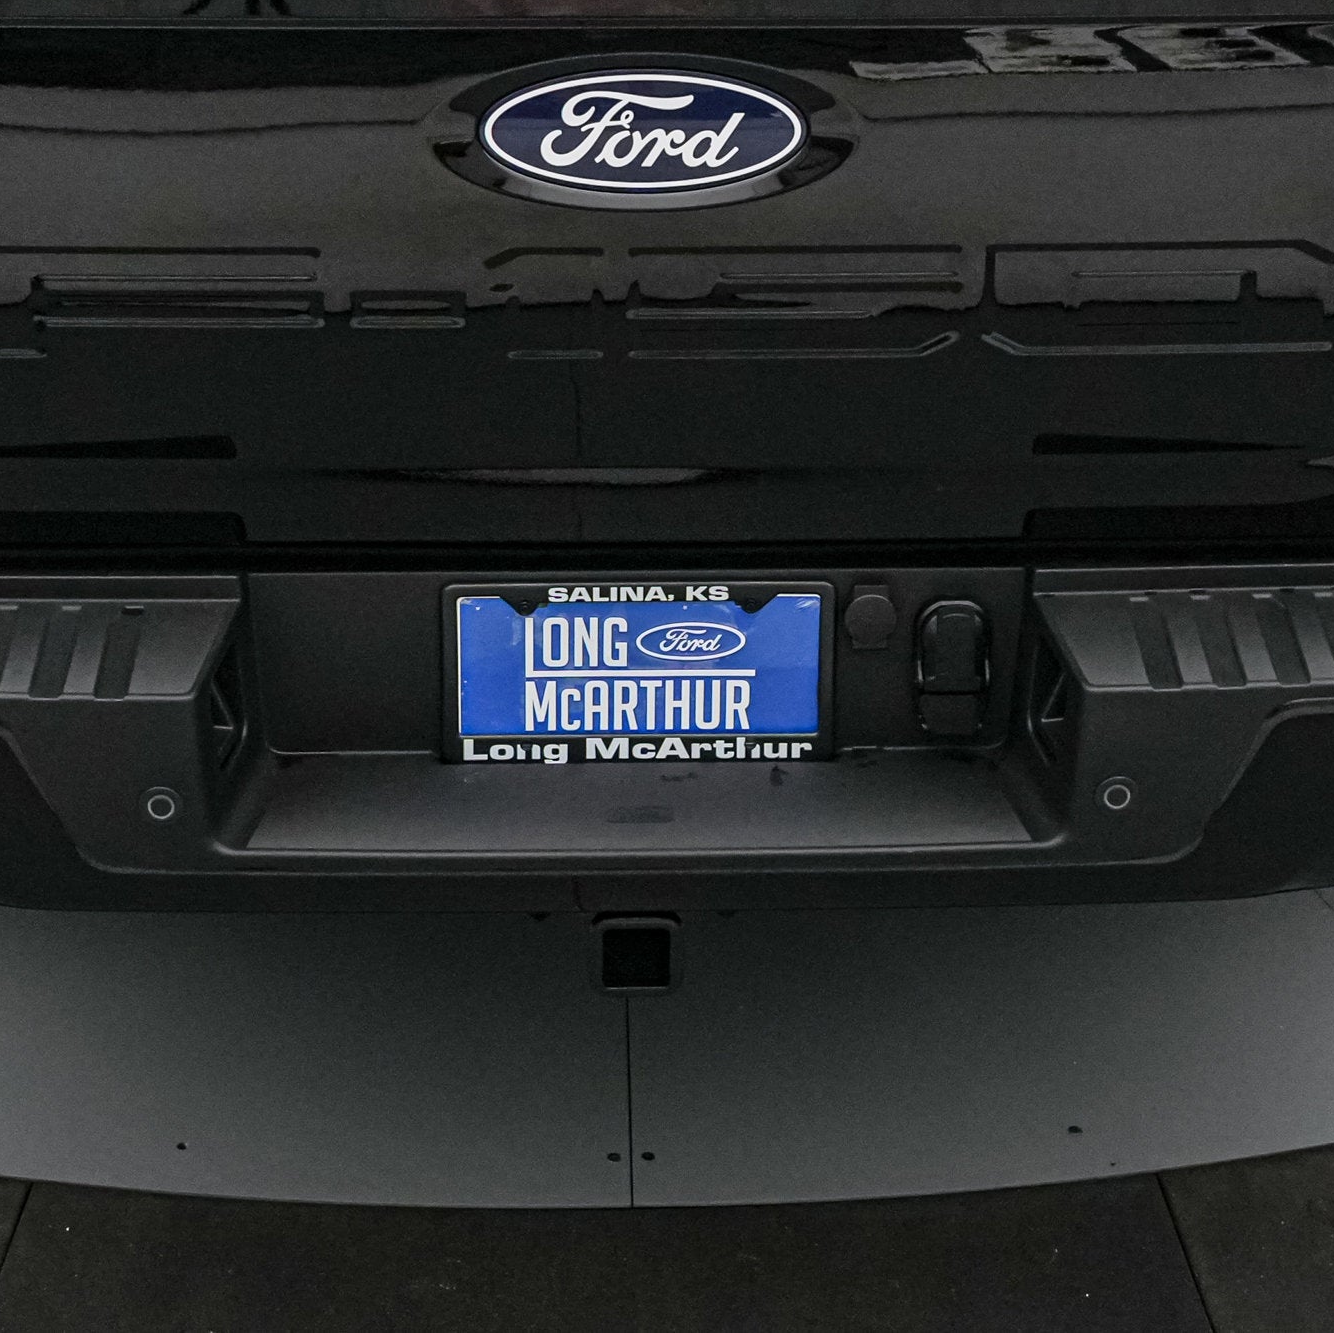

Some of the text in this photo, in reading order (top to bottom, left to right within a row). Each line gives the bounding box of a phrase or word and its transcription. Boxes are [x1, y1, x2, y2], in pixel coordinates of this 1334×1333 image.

[540, 90, 746, 168] Ford
[547, 585, 730, 603] SALINA, KS
[525, 616, 723, 675] LONG Ford
[524, 679, 751, 732] McARTHUR
[462, 737, 813, 764] Long McArthur
